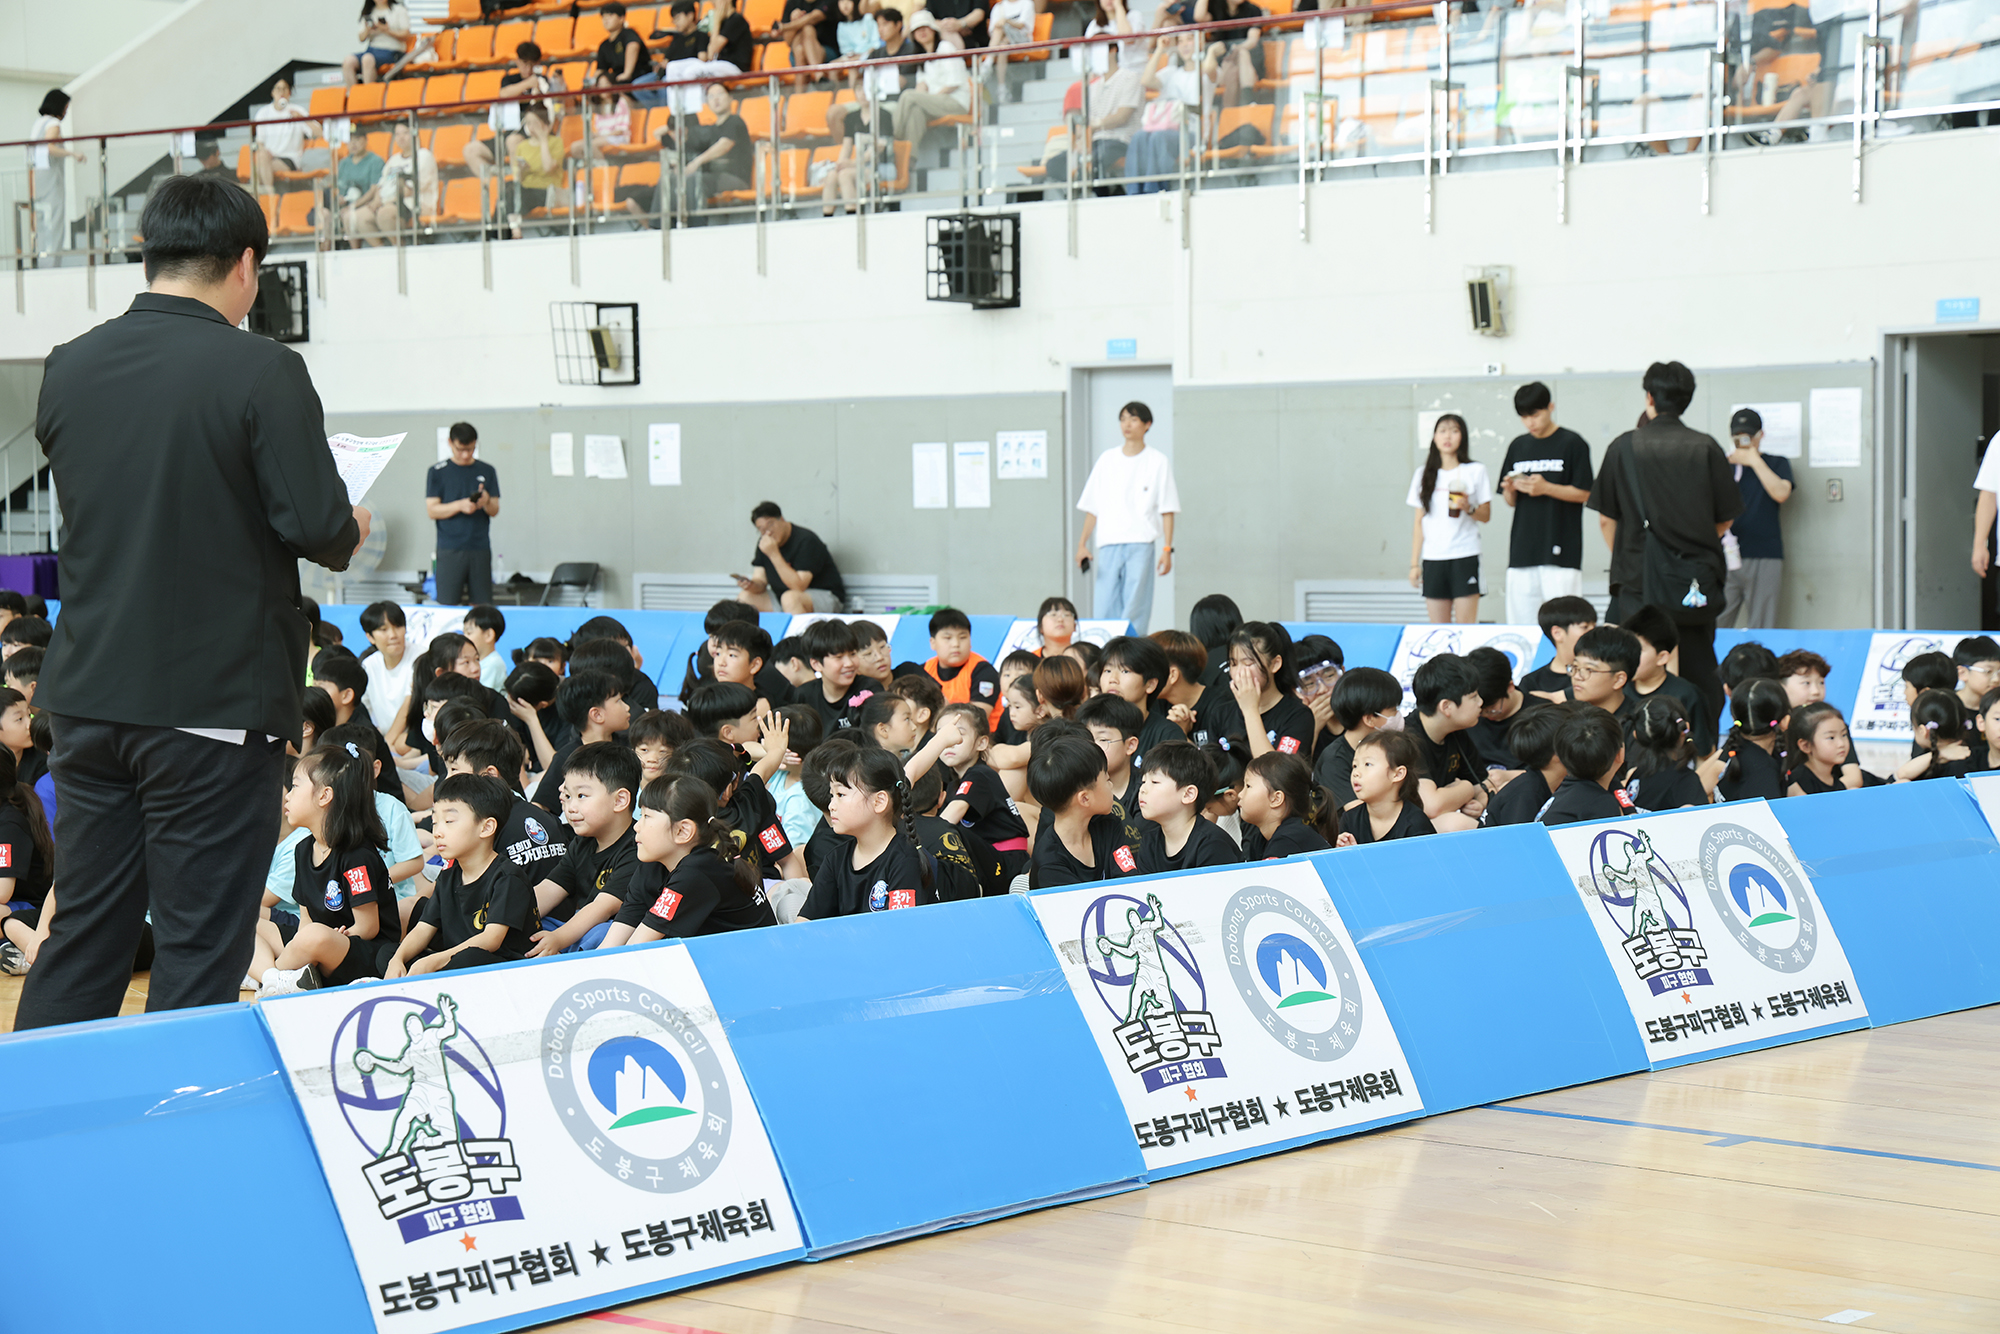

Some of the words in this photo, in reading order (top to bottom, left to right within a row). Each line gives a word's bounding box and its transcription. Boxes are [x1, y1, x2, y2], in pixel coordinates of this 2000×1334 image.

[761, 827, 778, 841] 국가
[767, 837, 784, 850] 대표
[1710, 828, 1744, 844] Sports
[1747, 833, 1793, 878] Council
[347, 869, 364, 883] 국가
[351, 880, 368, 892] 대표
[1703, 842, 1718, 891] Dobong
[653, 901, 671, 918] 대표
[659, 888, 676, 906] 국가
[892, 890, 911, 905] 국가
[1226, 908, 1245, 966] Dobong
[1238, 893, 1279, 911] Sports
[1284, 899, 1337, 951] Council
[1622, 928, 1707, 980] 도봉구
[548, 1006, 578, 1079] Dobong
[572, 986, 630, 1009] Sports
[638, 992, 707, 1055] Council
[1645, 1001, 1749, 1044] 도봉구피구협회
[1767, 980, 1852, 1018] 도봉구체육회
[1112, 1010, 1222, 1074] 도봉구
[1133, 1096, 1269, 1149] 도봉구피구협회
[1294, 1068, 1403, 1115] 도봉구체육회
[361, 1138, 521, 1220] 도봉구
[423, 1207, 459, 1232] 피구
[458, 1200, 496, 1225] 협회
[378, 1241, 579, 1316] 도봉구피구협회
[620, 1199, 776, 1262] 도봉구체육회
